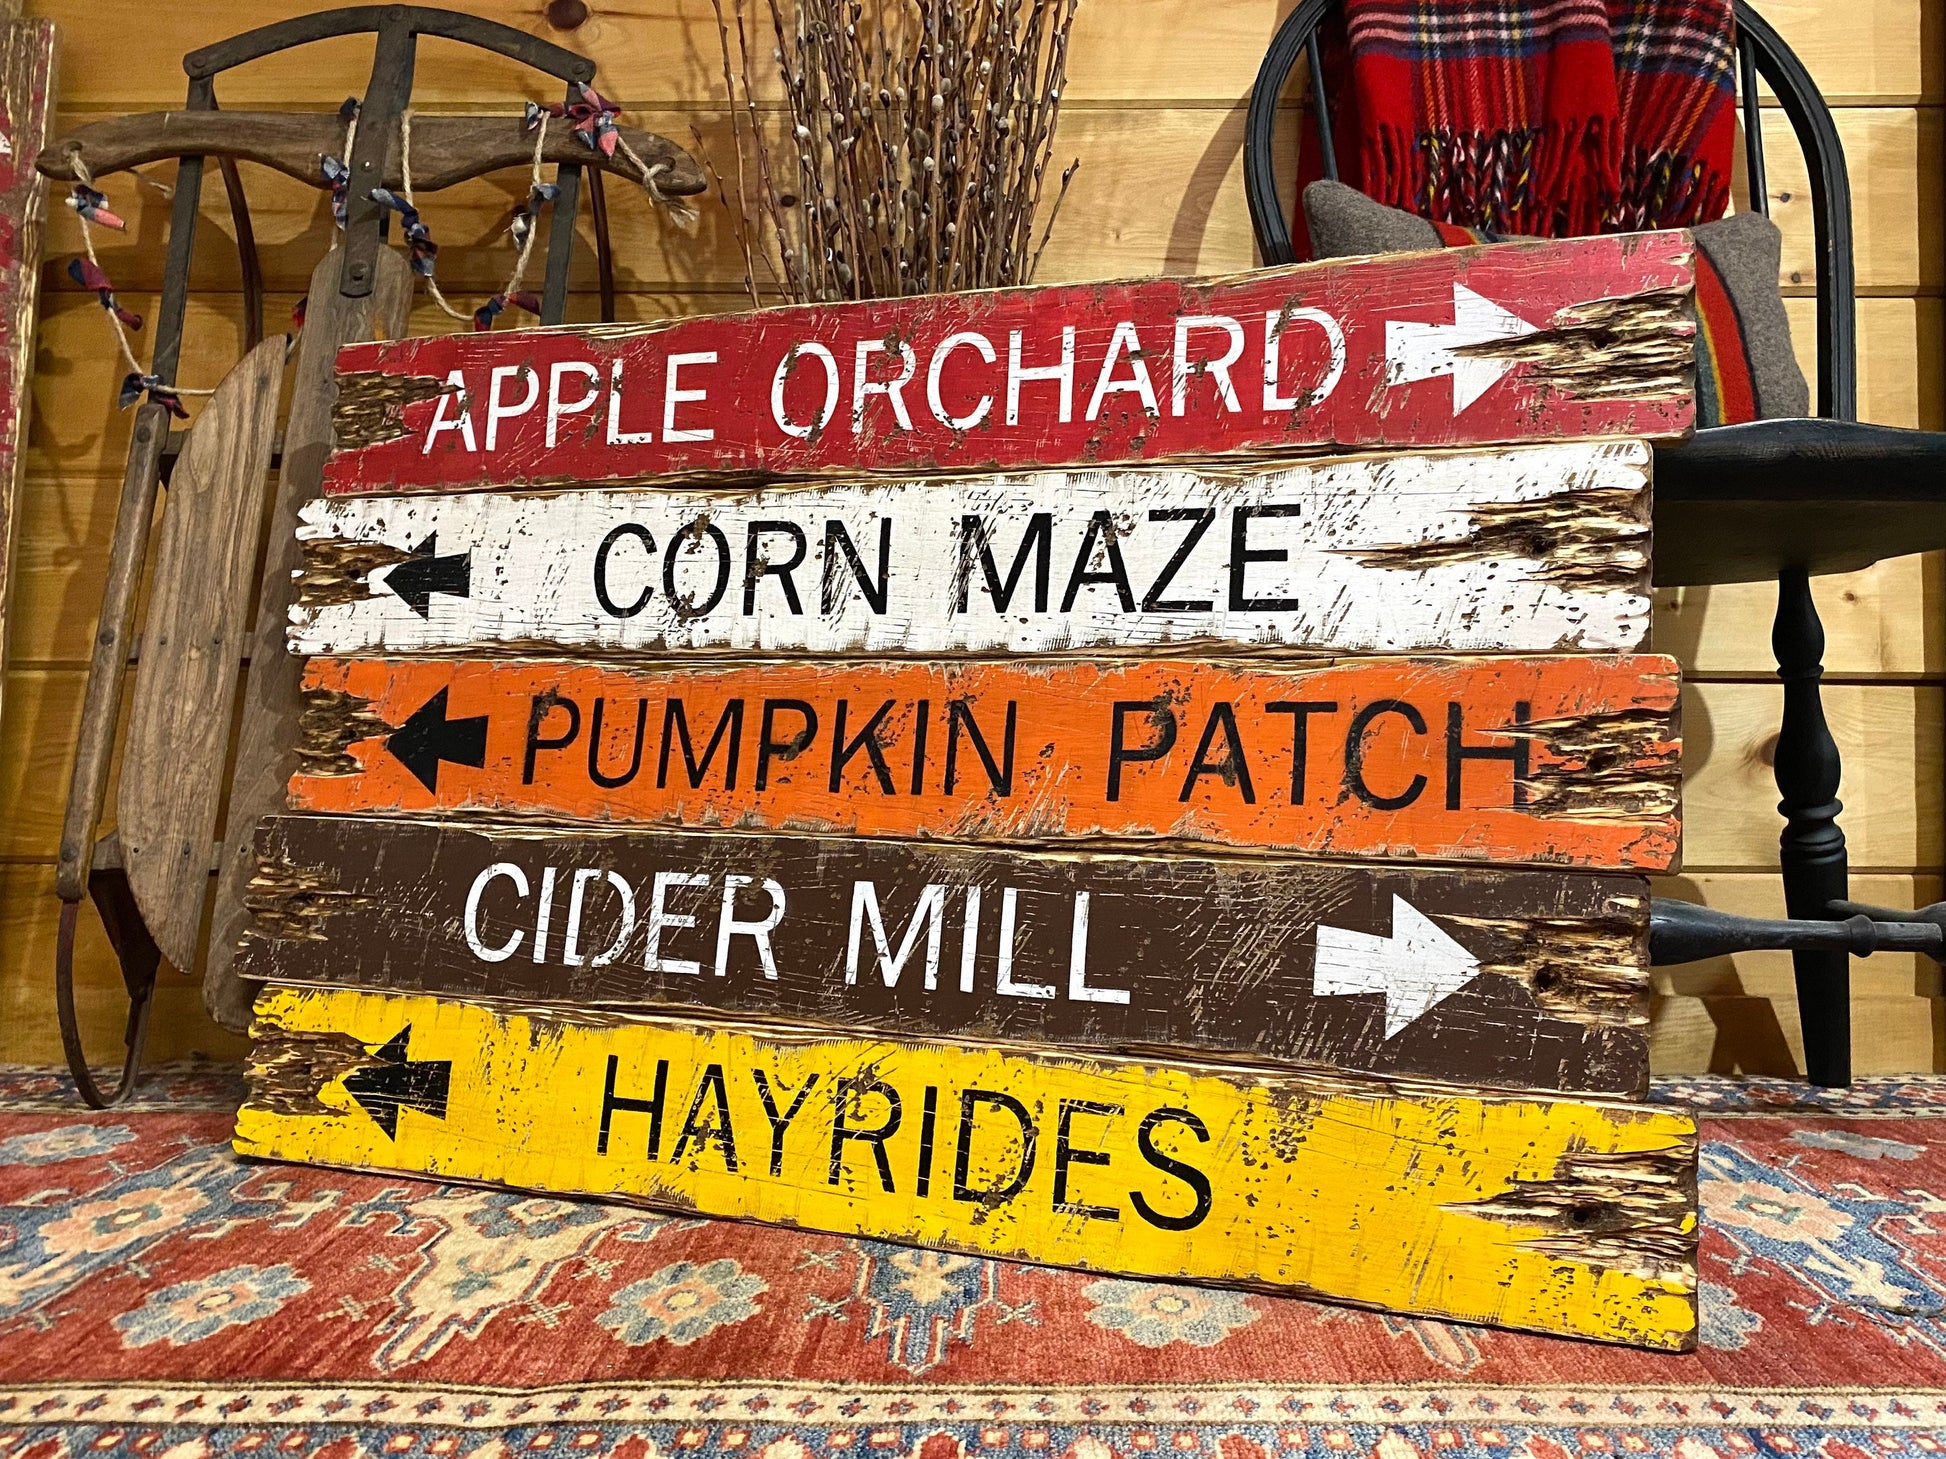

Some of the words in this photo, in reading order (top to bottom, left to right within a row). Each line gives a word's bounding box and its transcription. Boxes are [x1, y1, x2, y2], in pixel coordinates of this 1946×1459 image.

[422, 351, 718, 455] APPLE
[770, 306, 1348, 440] ORCHARD
[594, 515, 892, 618] CORN
[957, 503, 1301, 616] MAZE
[523, 697, 1018, 799] PUMPKIN
[1106, 699, 1530, 812] PATCH
[463, 862, 788, 982] CIDER
[844, 880, 1132, 1006] MILL
[597, 1055, 1212, 1232] HAYRIDES
